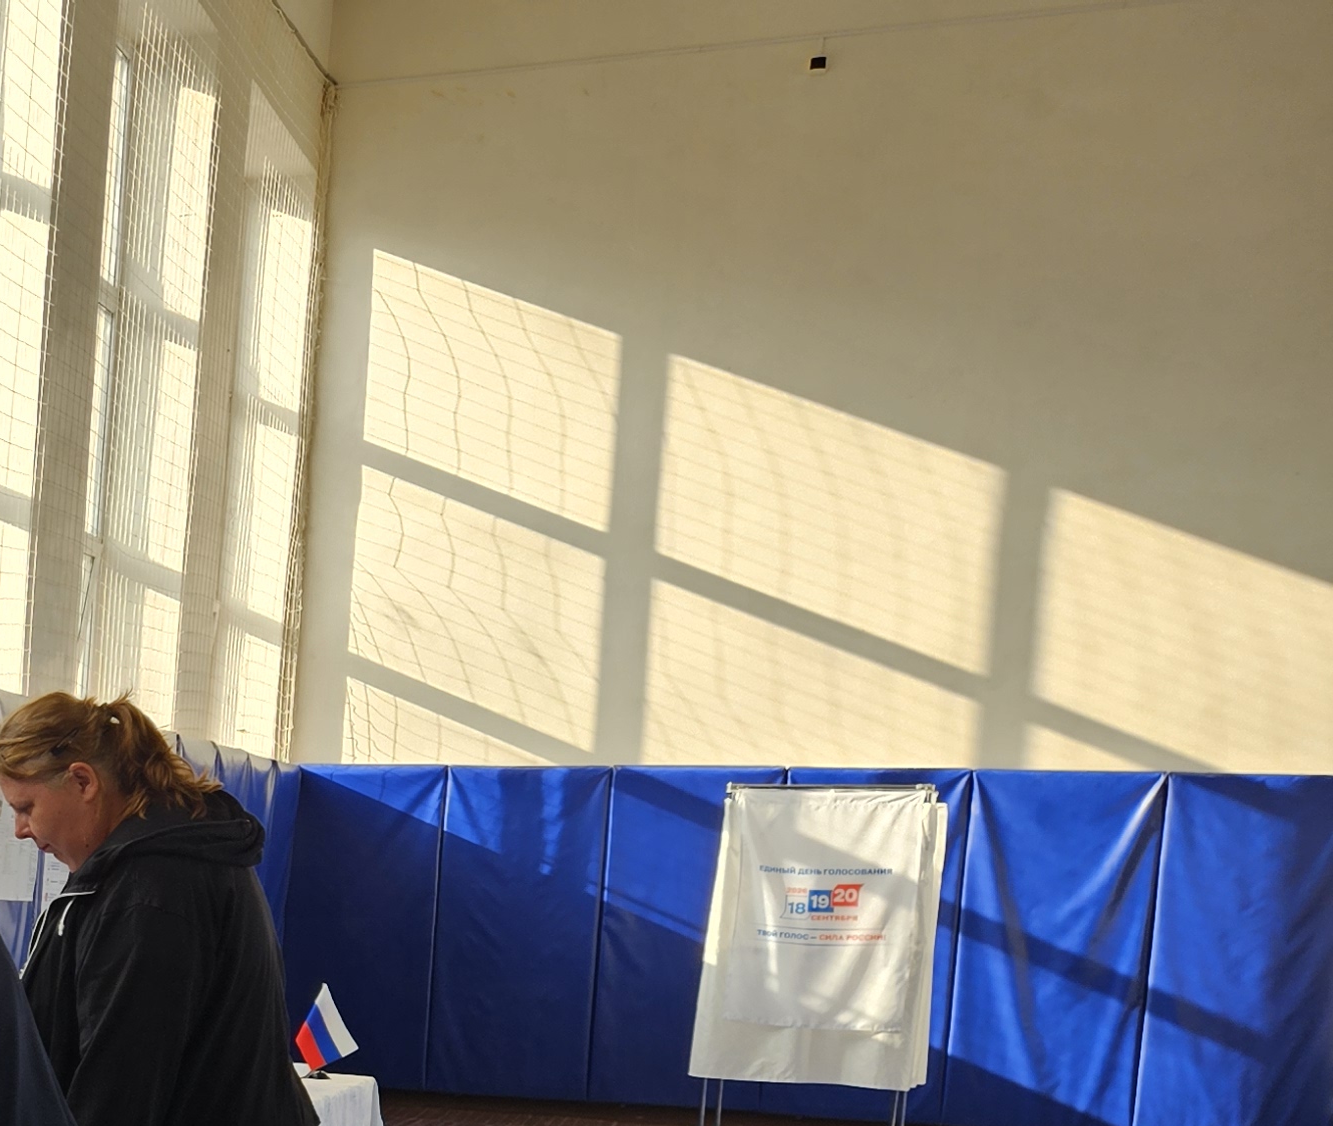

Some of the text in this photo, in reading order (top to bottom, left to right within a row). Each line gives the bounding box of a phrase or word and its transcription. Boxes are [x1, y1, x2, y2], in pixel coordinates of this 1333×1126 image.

[759, 865, 795, 874] ЕДИНЫЙ
[811, 895, 829, 908] 19
[834, 889, 857, 902] 20
[788, 902, 806, 914] 18
[779, 932, 809, 940] ГОЛОС
